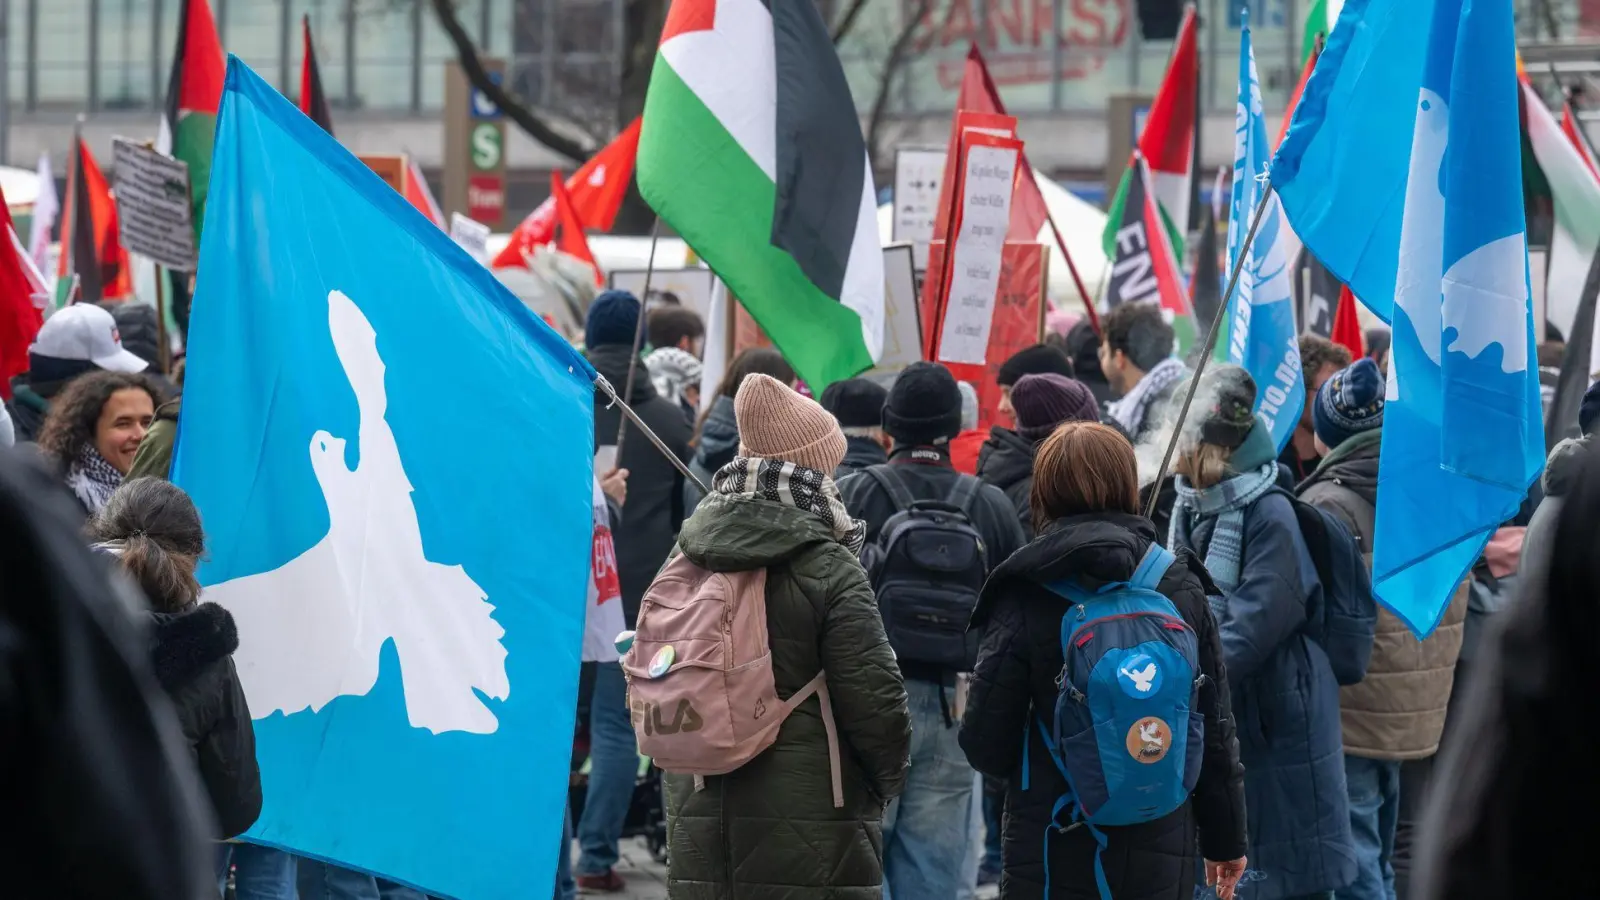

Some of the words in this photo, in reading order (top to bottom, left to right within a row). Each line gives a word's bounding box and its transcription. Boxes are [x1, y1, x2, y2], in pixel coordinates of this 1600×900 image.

[473, 124, 501, 168] S
[911, 450, 940, 461] Canon
[630, 698, 704, 737] FILA
